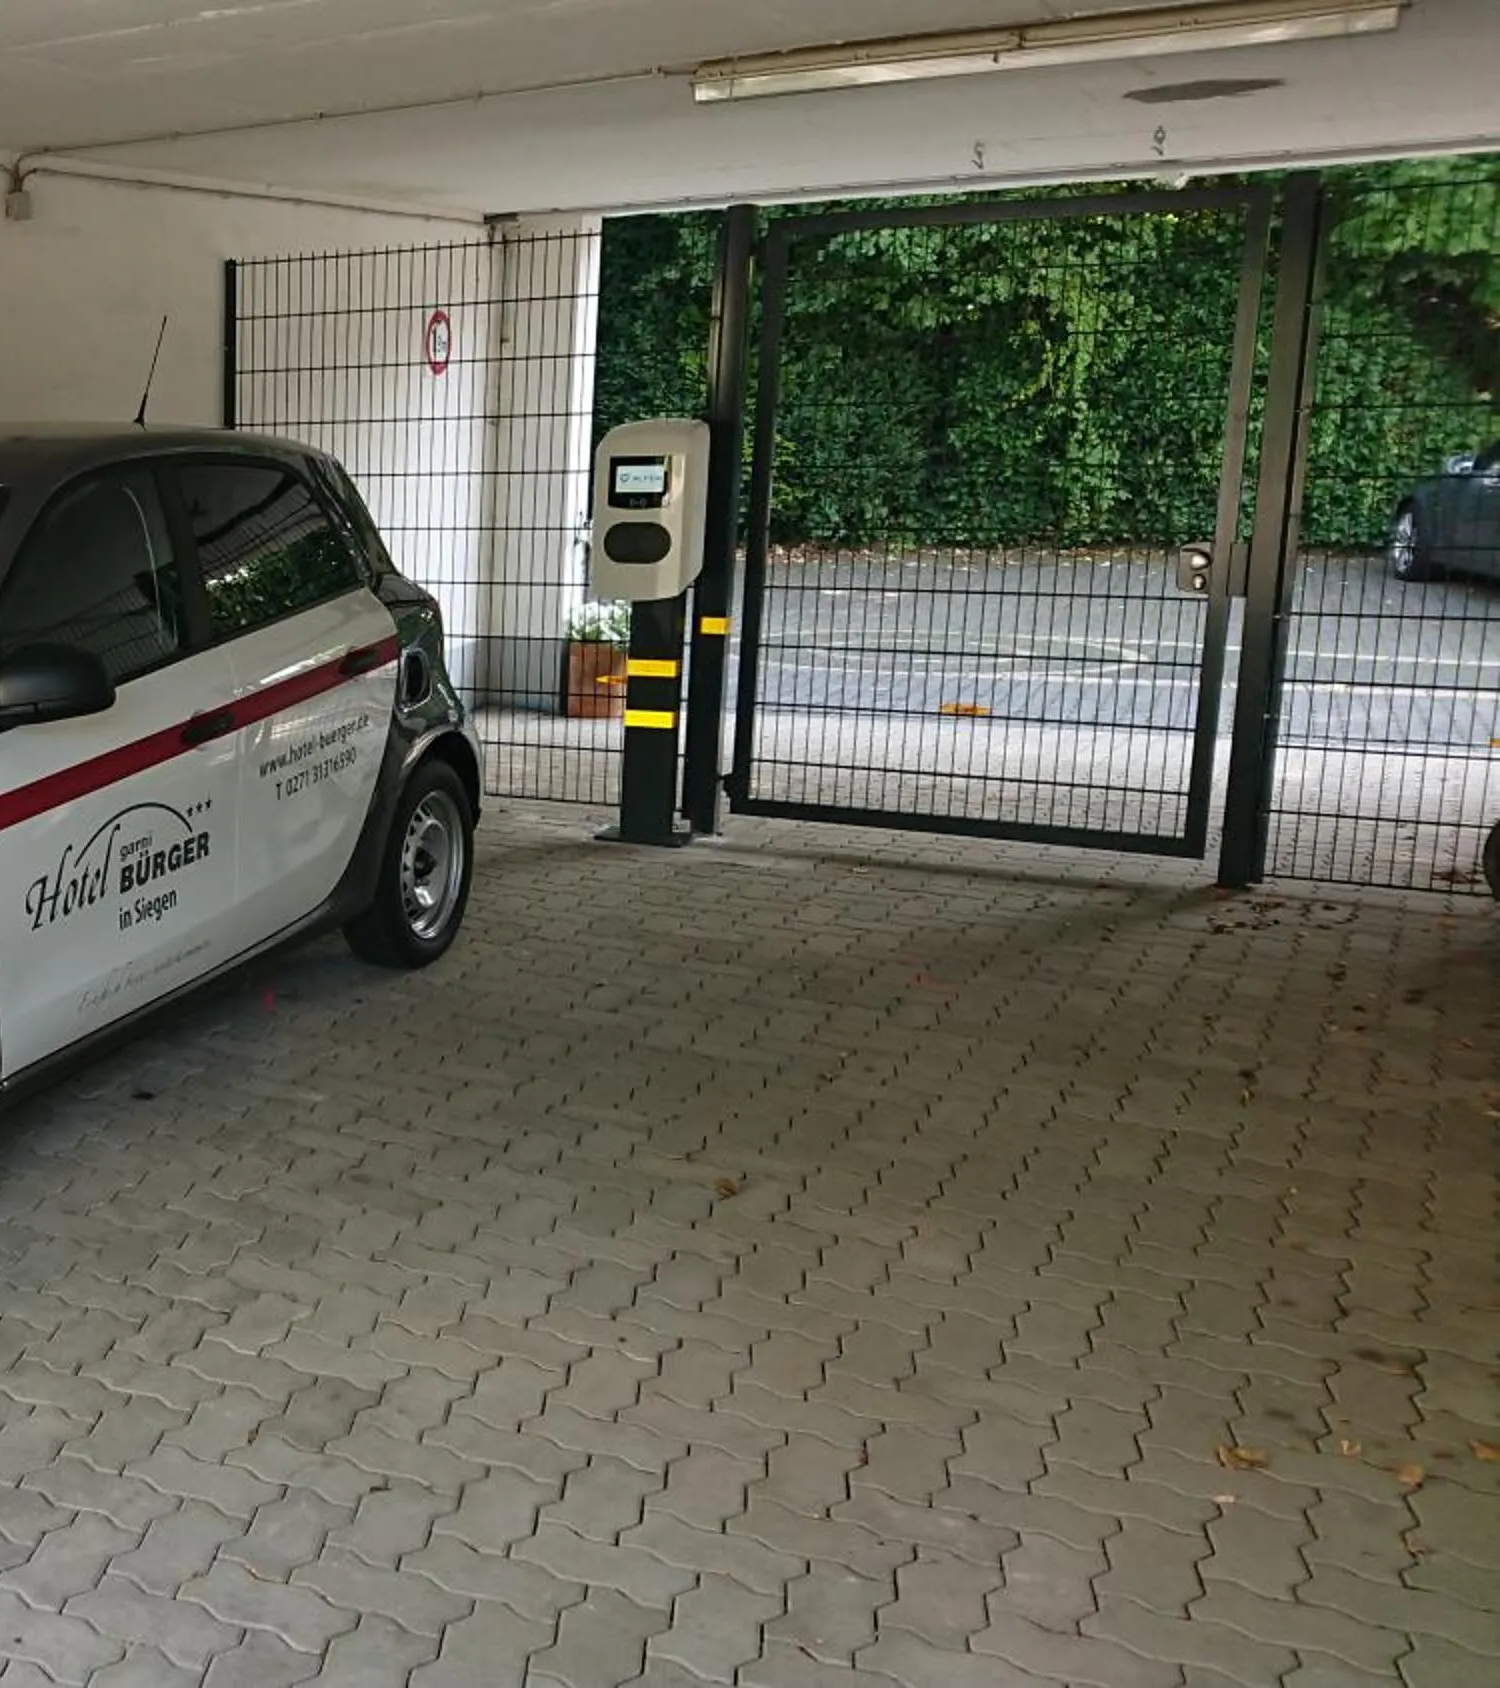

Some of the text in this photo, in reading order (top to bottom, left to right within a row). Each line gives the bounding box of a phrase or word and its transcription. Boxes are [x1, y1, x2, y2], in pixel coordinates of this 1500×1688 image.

[275, 781, 282, 801] T
[285, 768, 309, 797] 0271
[25, 823, 209, 930] Hotel BÜRGER
[119, 889, 177, 931] in Siegen
